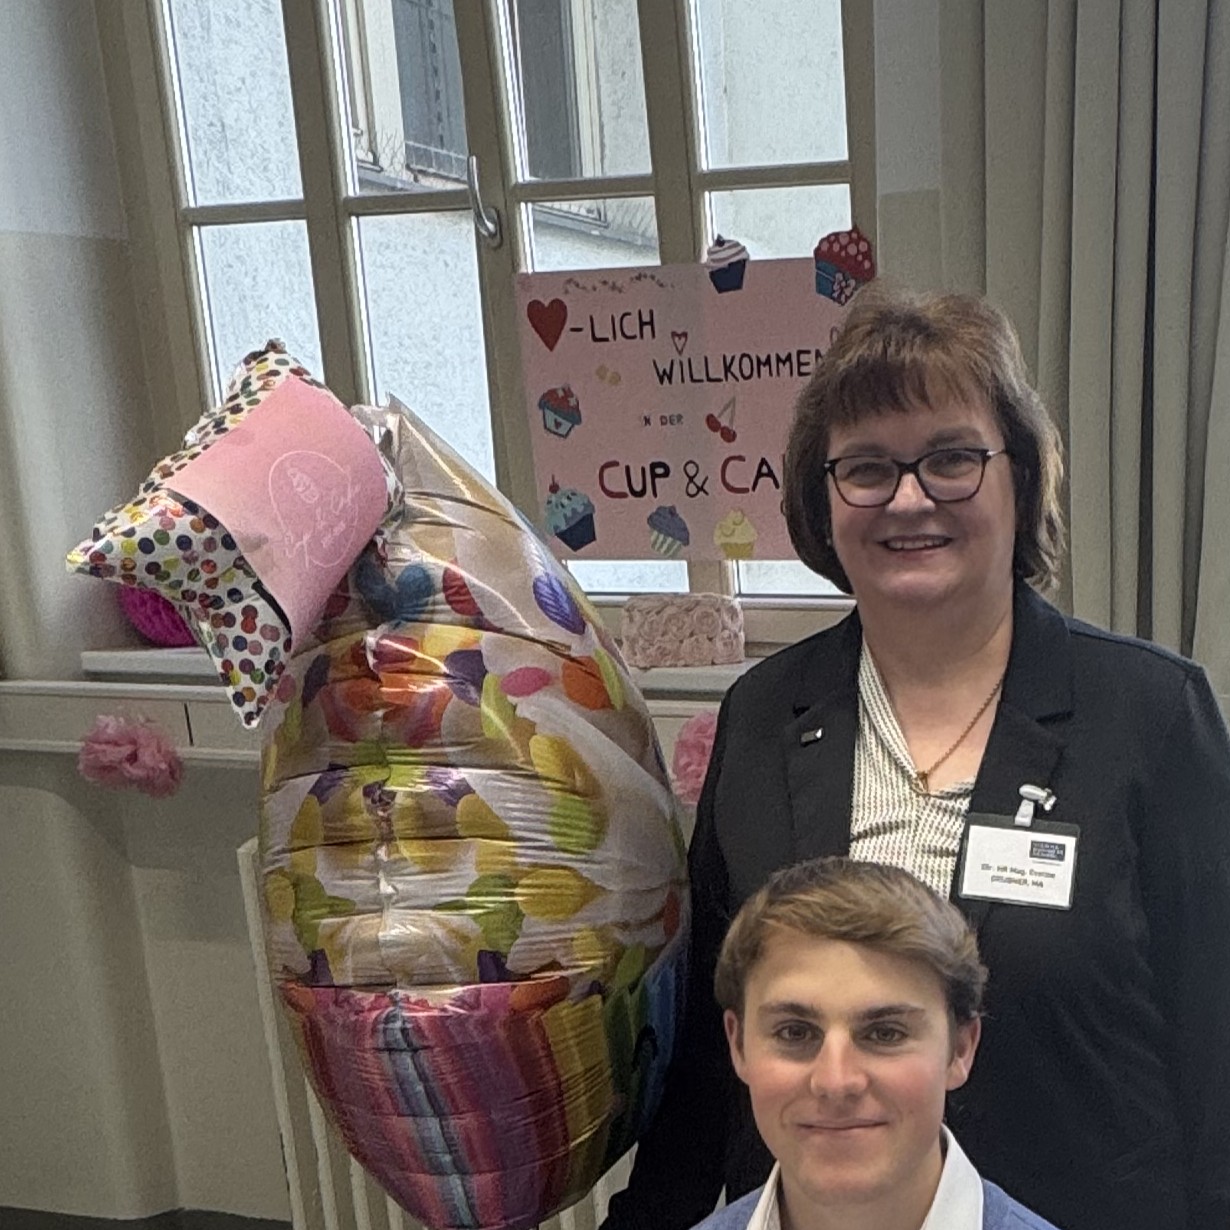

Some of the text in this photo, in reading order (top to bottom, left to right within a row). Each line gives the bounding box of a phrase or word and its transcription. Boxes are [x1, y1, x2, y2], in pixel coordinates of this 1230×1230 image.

[658, 413, 684, 426] DER
[598, 454, 785, 499] CUP & CA
